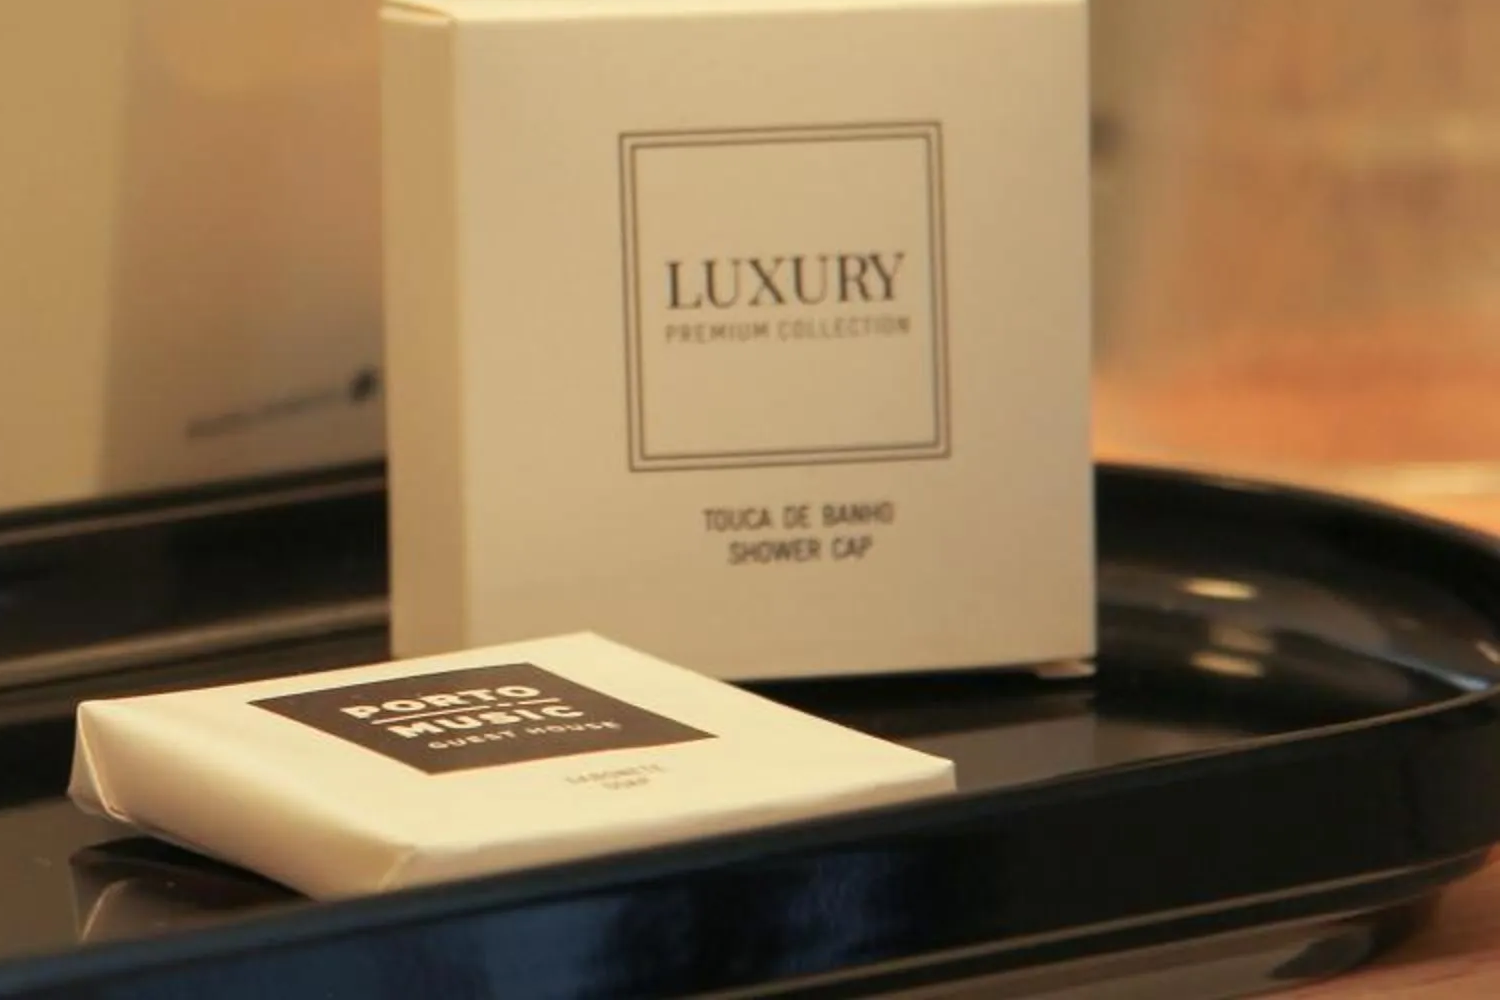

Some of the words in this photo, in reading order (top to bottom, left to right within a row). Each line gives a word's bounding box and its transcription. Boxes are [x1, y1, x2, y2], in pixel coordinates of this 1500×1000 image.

[665, 251, 905, 310] LUXURY
[665, 320, 770, 344] PREMIUM
[777, 315, 911, 341] COLLECTION
[703, 507, 773, 533] TOUCA
[782, 504, 812, 530] DE
[822, 501, 894, 528] BANHO
[727, 538, 821, 566] SHOWER
[831, 533, 873, 561] CAP
[339, 685, 541, 720] PORTO
[387, 705, 584, 739] MUSIC
[427, 729, 517, 750] GUEST
[525, 720, 622, 736] HOUSE
